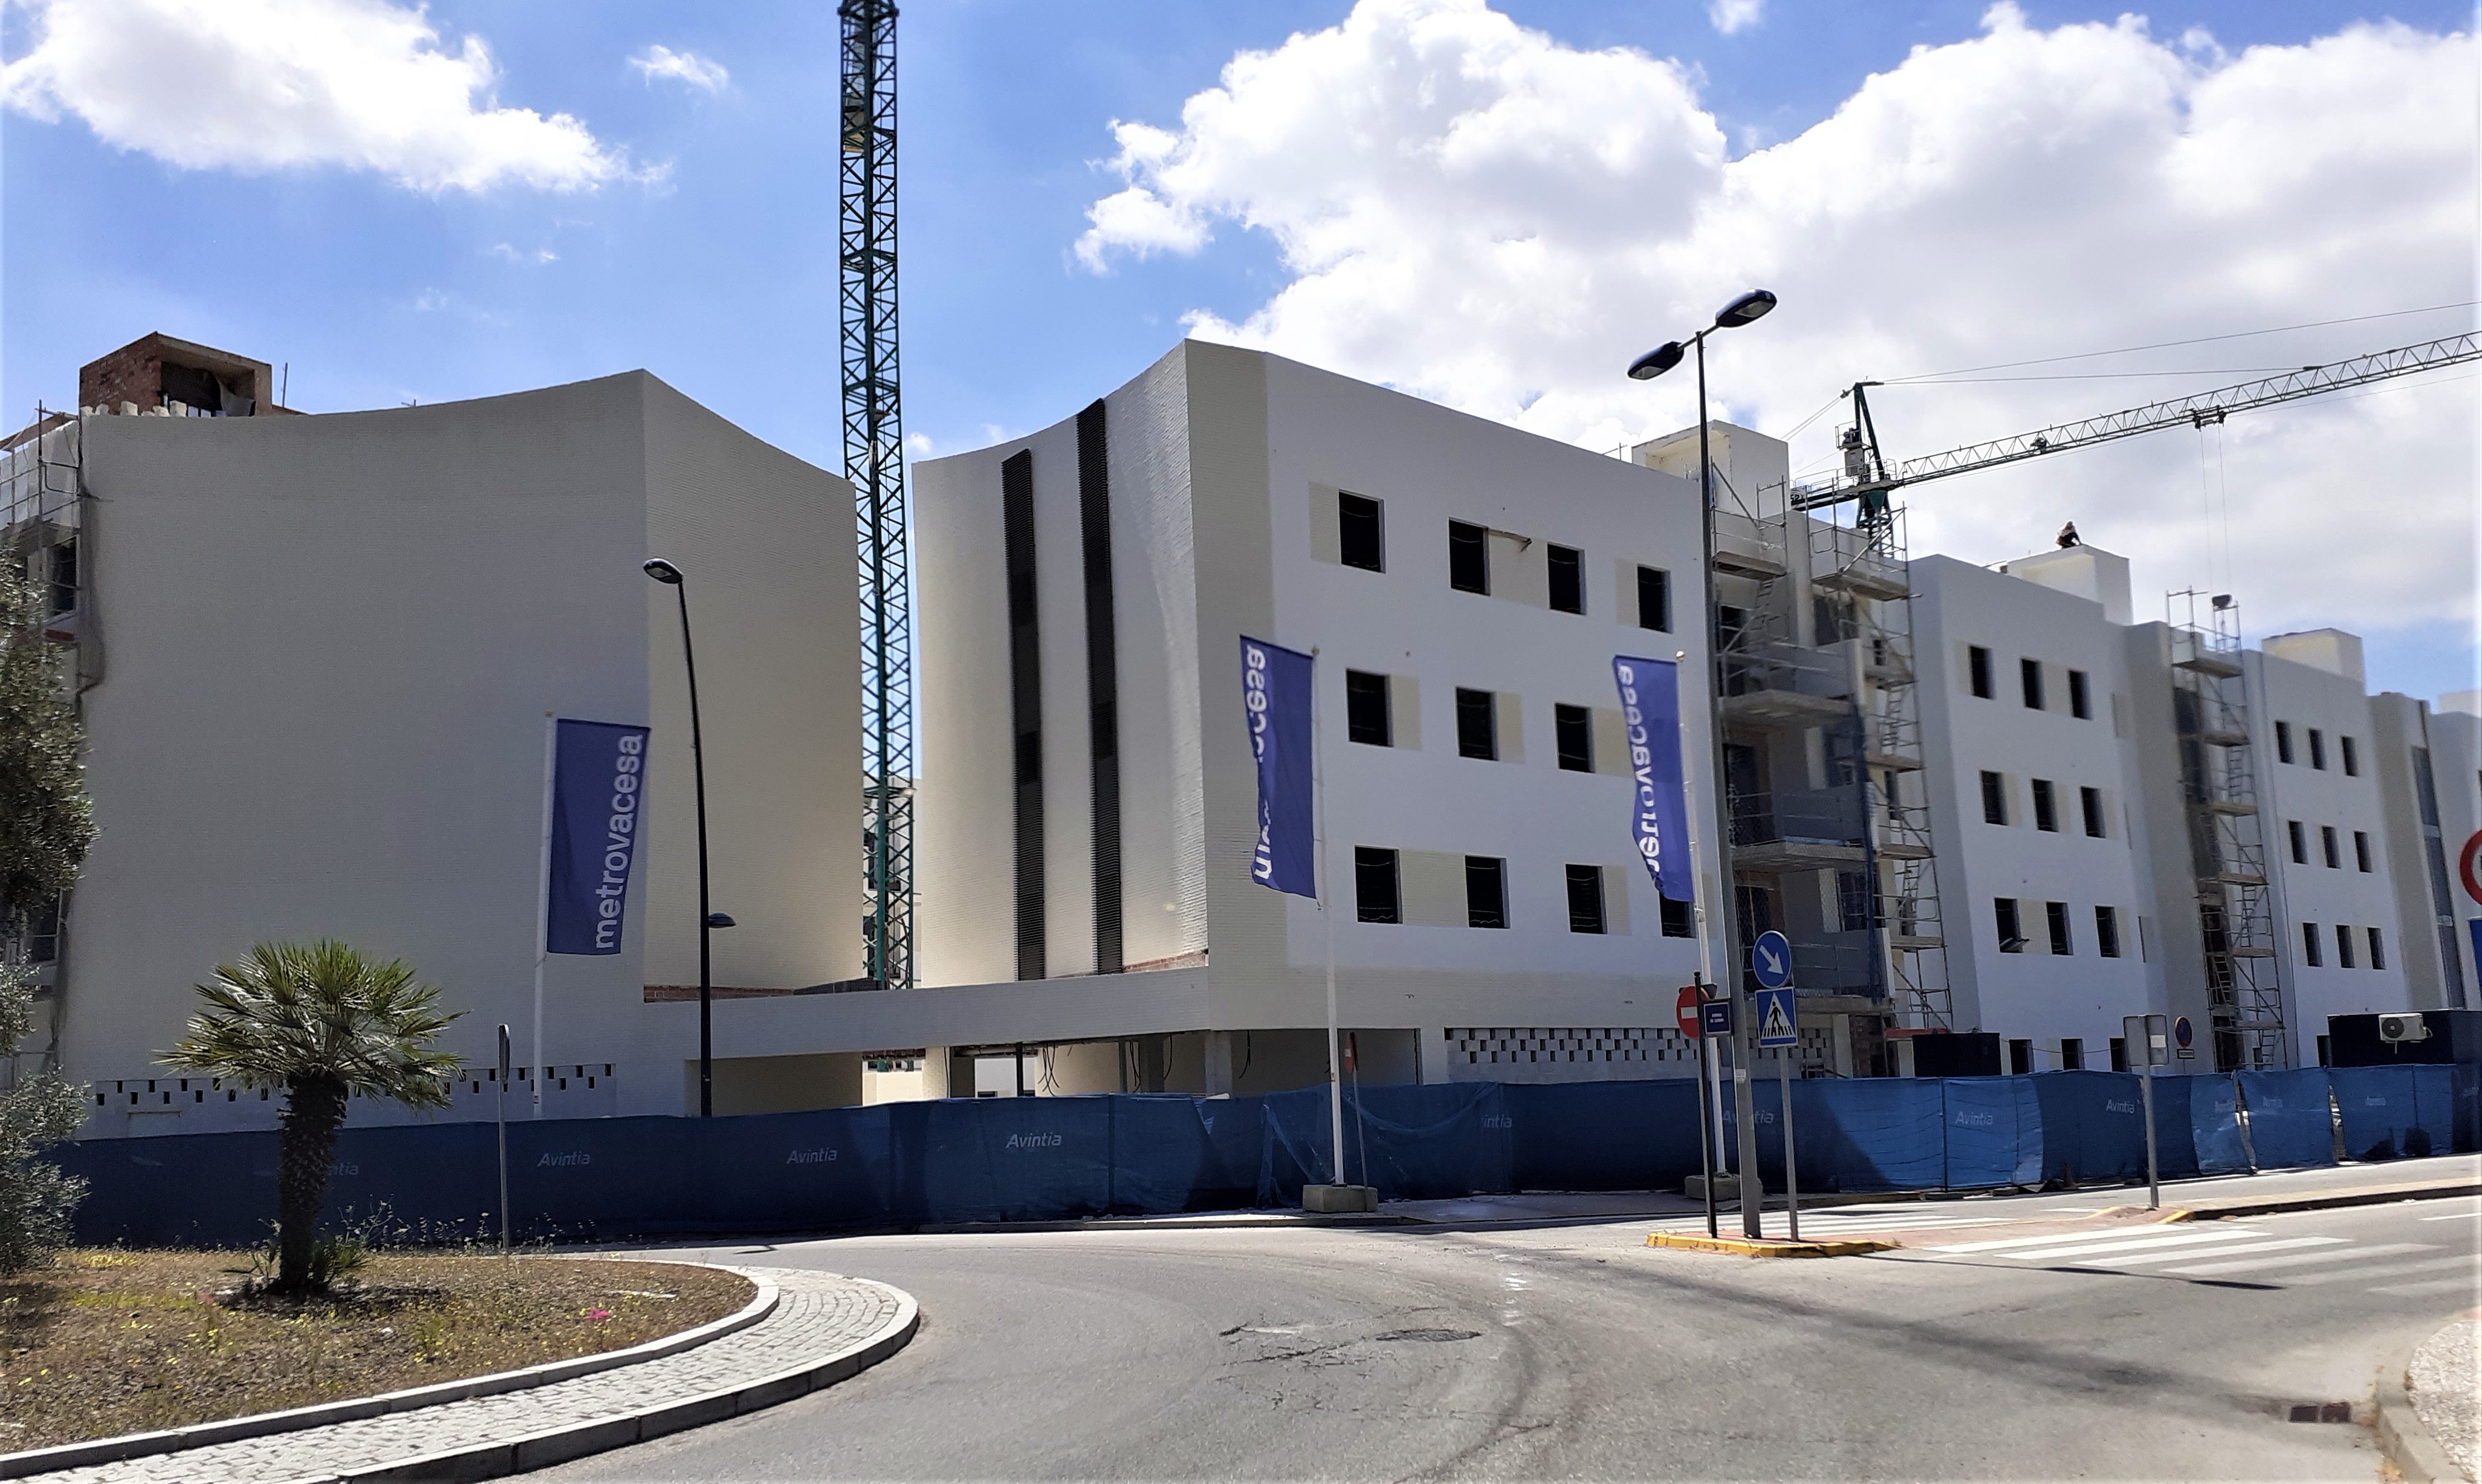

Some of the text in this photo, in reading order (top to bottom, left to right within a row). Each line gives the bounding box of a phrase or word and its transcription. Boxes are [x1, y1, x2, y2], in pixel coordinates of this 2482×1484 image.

[595, 734, 643, 949] metrovacesa
[1723, 1110, 1774, 1124] Avtia
[1005, 1131, 1062, 1149] Avintia
[537, 1150, 591, 1168] Avintia
[786, 1147, 837, 1164] Avintia
